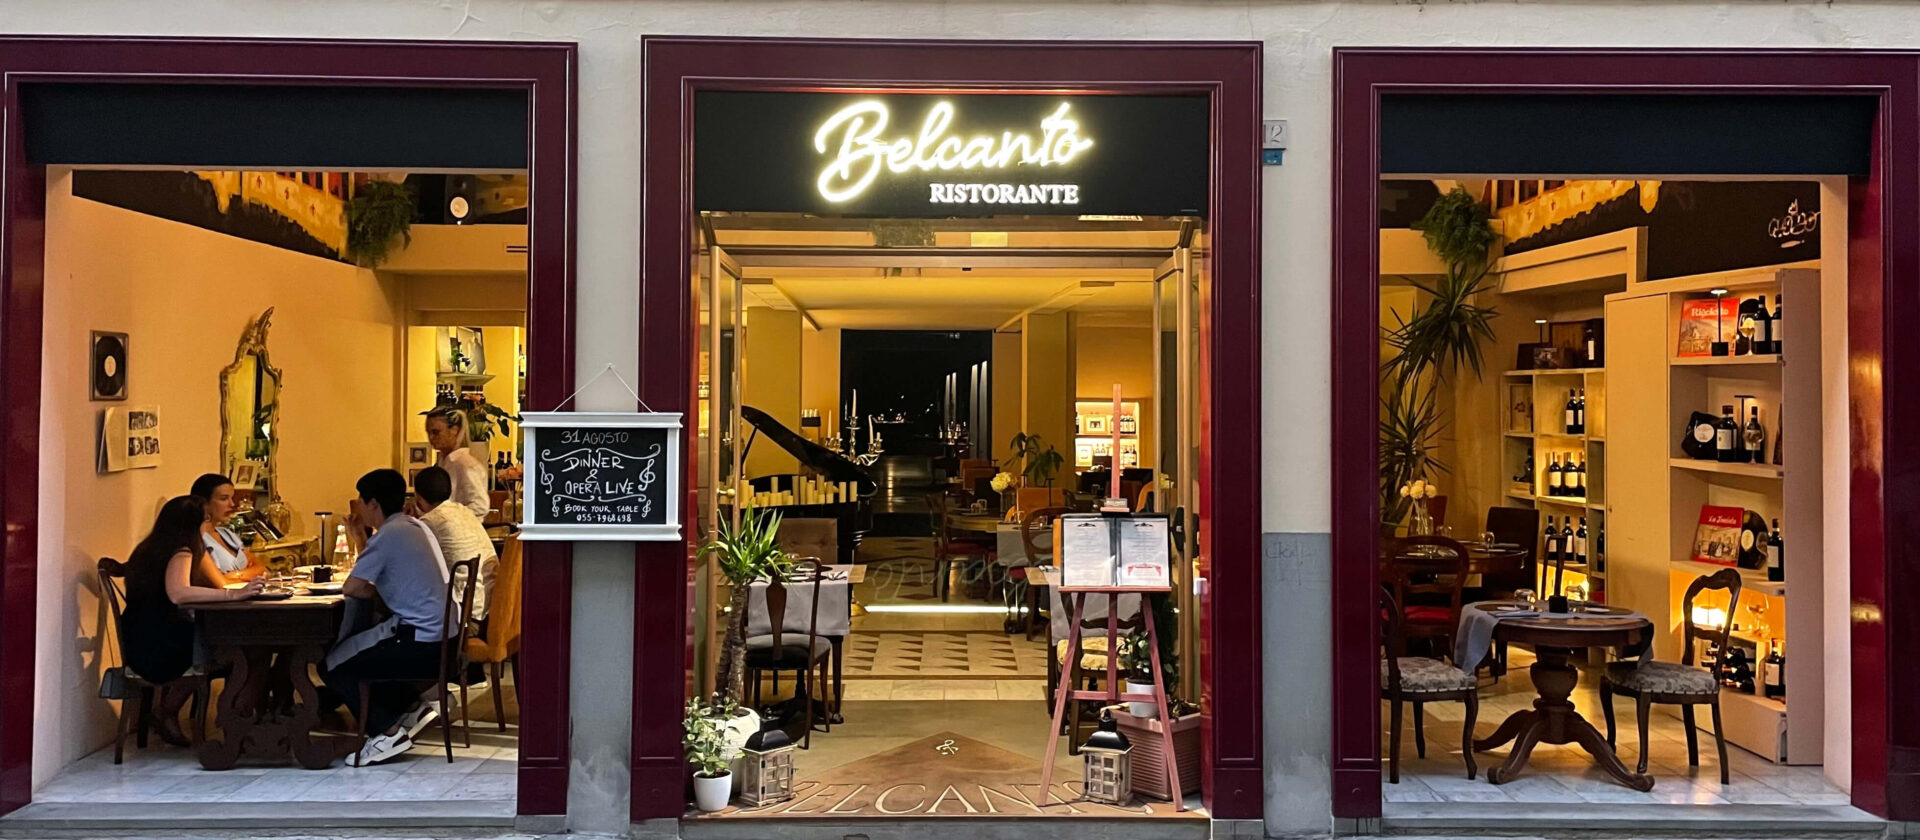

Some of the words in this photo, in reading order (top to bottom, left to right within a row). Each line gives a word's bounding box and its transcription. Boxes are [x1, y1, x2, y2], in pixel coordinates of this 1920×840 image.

[814, 100, 1094, 203] Belcanto
[929, 183, 1080, 205] RISTORANTE
[1691, 307, 1729, 317] Rigoleto
[561, 429, 580, 444] 31
[582, 432, 629, 445] AGOSTO
[561, 451, 625, 473] DINNER
[585, 468, 598, 484] &
[565, 480, 602, 495] OPERA
[606, 478, 635, 495] LIVE
[563, 503, 588, 515] BOOK
[591, 505, 612, 513] YOUR
[617, 505, 639, 513] TABLE
